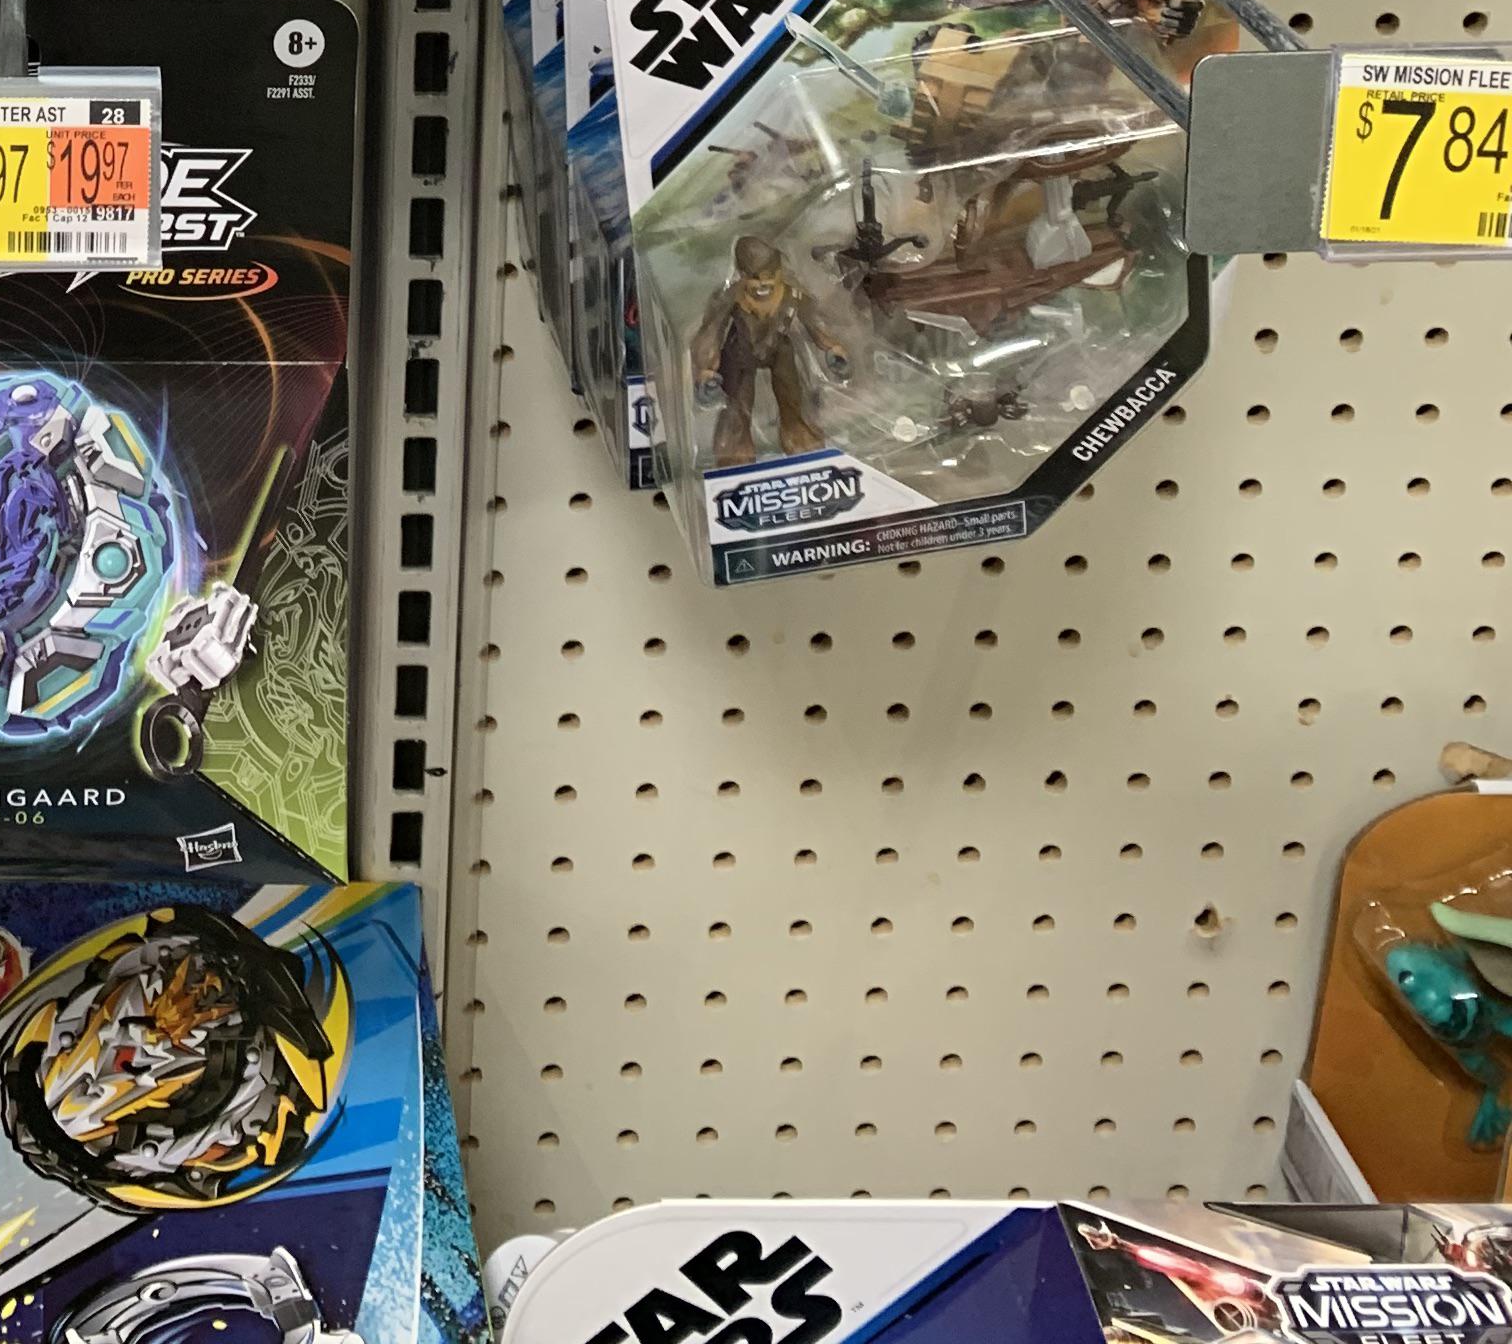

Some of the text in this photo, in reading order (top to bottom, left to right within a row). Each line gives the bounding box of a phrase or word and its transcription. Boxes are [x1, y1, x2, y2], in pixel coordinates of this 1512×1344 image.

[288, 31, 317, 55] 8+
[1362, 65, 1464, 87] SW MISSION
[1410, 92, 1445, 102] PRICE
[36, 107, 66, 122] AST
[101, 108, 125, 124] 28
[46, 130, 71, 140] UNIT
[74, 130, 106, 140] PRICE
[22, 214, 88, 225] Fac Cap 12
[95, 206, 134, 221] 9817
[127, 269, 260, 284] PRO SERIES
[1072, 365, 1174, 463] CHEWBACCA
[721, 477, 856, 518] MISSION
[758, 507, 825, 526] FLEET
[772, 539, 871, 568] WARNING:
[1309, 1275, 1453, 1292] STAR WARS
[1288, 1293, 1506, 1329] MISSION
